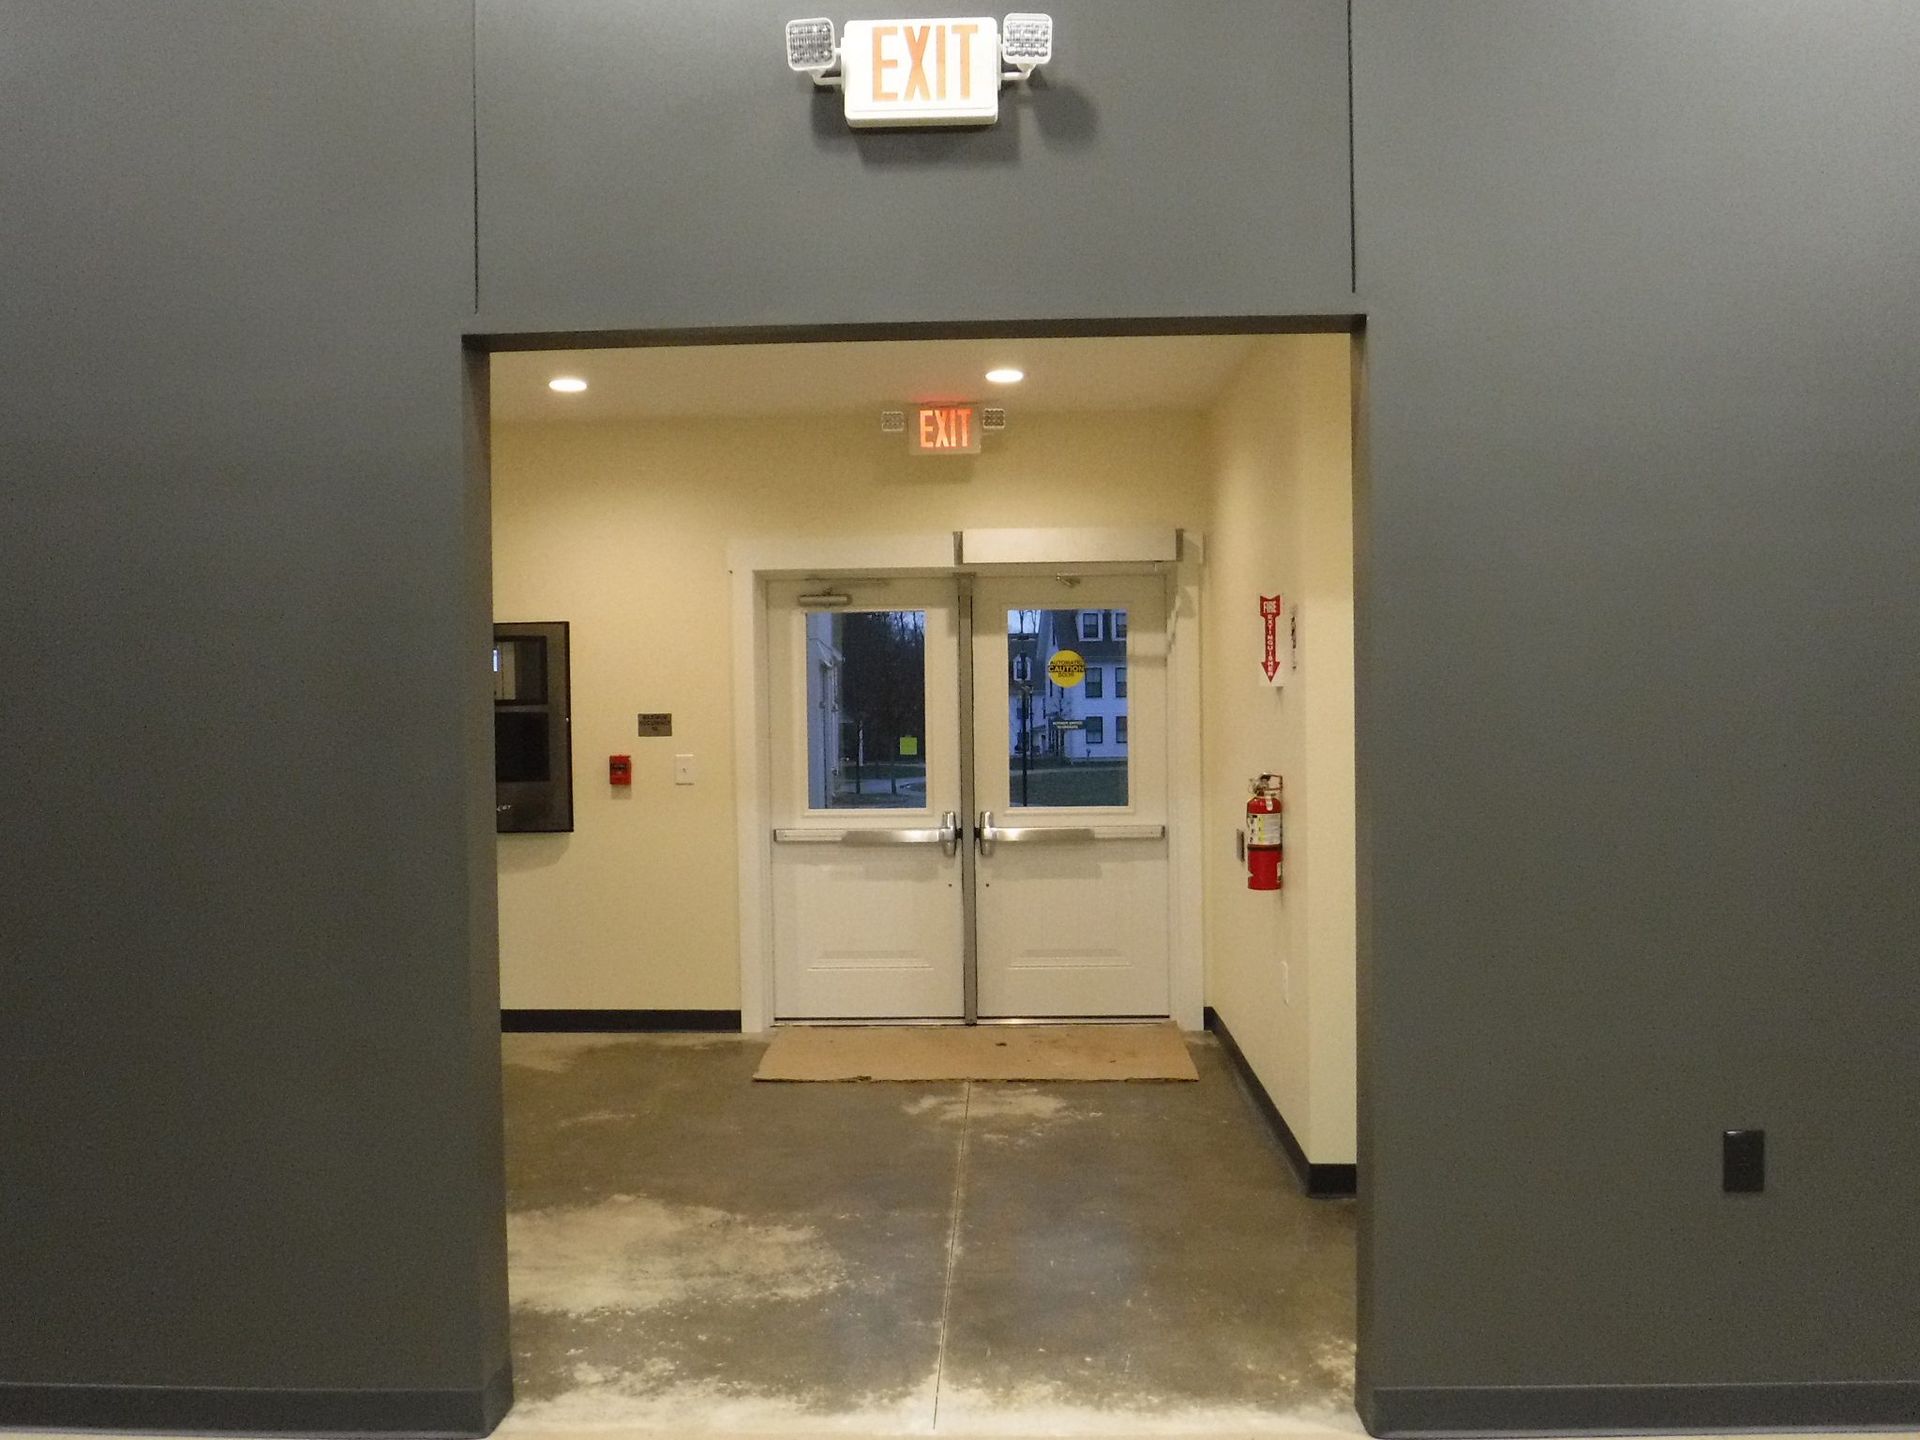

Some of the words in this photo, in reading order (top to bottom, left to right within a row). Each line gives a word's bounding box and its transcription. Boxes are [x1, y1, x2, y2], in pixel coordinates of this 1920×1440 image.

[872, 24, 979, 102] EXIT
[919, 408, 972, 448] EXIT
[1263, 601, 1277, 614] FIRE
